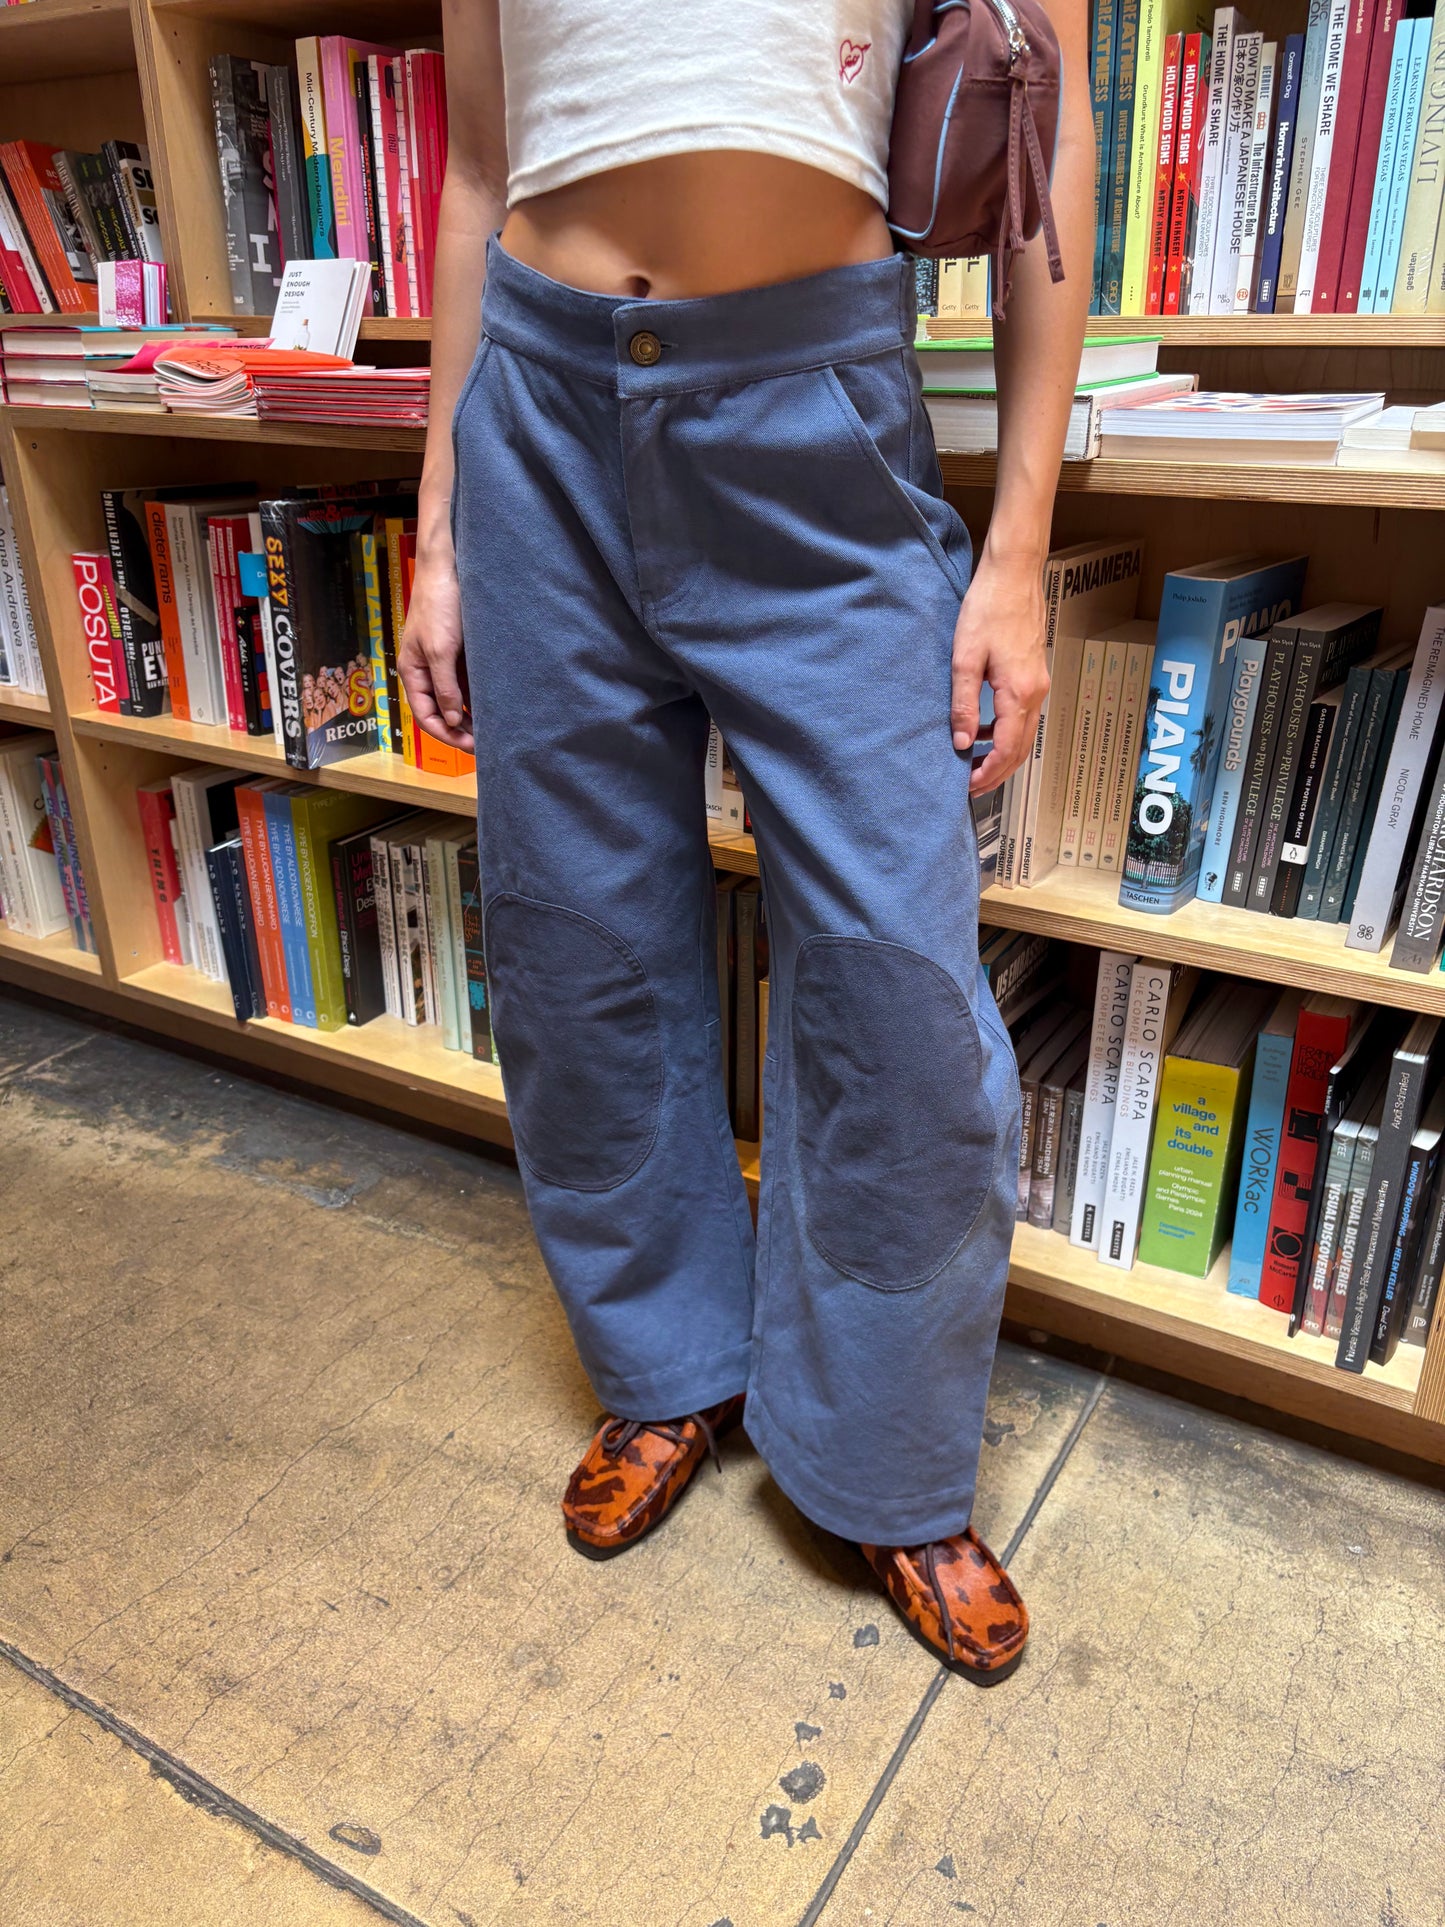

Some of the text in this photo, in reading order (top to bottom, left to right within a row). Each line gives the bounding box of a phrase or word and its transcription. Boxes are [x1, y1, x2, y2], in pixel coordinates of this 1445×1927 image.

[1208, 24, 1228, 147] THE HOME WE SHARE
[1229, 38, 1248, 133] 日本の家の作り方
[1320, 5, 1346, 136] THE HOME WE SHARE
[1160, 66, 1177, 165] HOLLYWOOD SIGNS
[1179, 64, 1196, 164] HOLLYWOOD SIGNS
[1380, 58, 1404, 182] LEARNING FROM LAS VEGAS
[1397, 57, 1422, 182] LEARNING FROM LAS VEGAS
[305, 72, 325, 238] Mid-Century Modern Designers
[1230, 36, 1260, 255] HOW TO MAKE A JAPANESE HOUSE
[1294, 137, 1307, 209] STEPHEN GEE
[330, 136, 351, 226] Mendini
[1243, 142, 1265, 238] The Infrastructure Book
[1267, 121, 1290, 235] Horror in Architecture
[1154, 190, 1166, 257] KATHY KIKKERT
[1172, 189, 1185, 257] KATHY KIKKERT
[1406, 252, 1418, 291] gestalten
[103, 493, 122, 557] EVERYTHING
[152, 511, 172, 605] dieter rams
[265, 536, 289, 607] SEXY
[1062, 549, 1141, 600] PANAMERA
[3, 571, 23, 648] Andreeva
[73, 559, 118, 705] POSUTA
[120, 606, 131, 631] DEAD
[274, 613, 302, 739] COVERS
[1409, 627, 1445, 740] THE REIMAGINED HOME
[325, 717, 377, 743] RECOR
[1034, 714, 1046, 760] PANAMERA
[1080, 716, 1090, 752] PARADISE
[1225, 658, 1259, 772] Playgrounds
[1245, 651, 1285, 816] PLAYHOUSES AND PRIVILEGE
[1270, 655, 1313, 821] PLAYHOUSES AND PRIVILEGE
[1075, 765, 1084, 789] SMALL
[1079, 754, 1086, 764] OF
[1139, 659, 1196, 836] PIANO
[1072, 791, 1081, 818] HOUSES
[1214, 804, 1226, 846] HIGHMORE
[1387, 768, 1410, 830] NICOLE GRAY
[269, 822, 279, 843] TYPE
[283, 823, 291, 844] TYPE
[298, 827, 307, 847] TYPE
[996, 834, 1007, 878] POURSUITE
[1004, 838, 1015, 882] POURSUITE
[1022, 837, 1033, 881] POURSUITE
[231, 860, 246, 930] TO EVELYN
[275, 856, 284, 878] ALDO
[288, 857, 297, 880] ALDO
[303, 859, 313, 889] ROGER
[1406, 793, 1445, 937] HOUGHTON LIBRARY HARVARD UNIVERSITY
[209, 864, 226, 934] TO EVELYN
[279, 879, 291, 925] NOVARESE
[291, 880, 303, 928] NOVARESE
[306, 889, 318, 938] EXCOFFON
[1126, 891, 1160, 905] TASCHEN
[1089, 963, 1113, 1102] THE COMPLETE BUILDINGS
[1101, 964, 1131, 1105] CARLO SCARPA
[1119, 975, 1146, 1118] THE COMPLETE BUILDINGS
[1131, 978, 1164, 1121] CARLO SCARPA
[1172, 1103, 1217, 1121] village
[1193, 1121, 1219, 1136] and
[1197, 1096, 1206, 1106] a
[1167, 1138, 1214, 1158] double
[1175, 1126, 1192, 1139] its
[1337, 1137, 1350, 1158] YEE
[1360, 1140, 1374, 1161] YEE
[1155, 1193, 1180, 1205] Games
[1156, 1186, 1207, 1205] and Paralympic
[1158, 1169, 1213, 1188] planning manual
[1171, 1182, 1200, 1195] Olympic
[1174, 1165, 1194, 1175] urban
[1243, 1127, 1276, 1215] WORKac
[1273, 1260, 1296, 1272] Robert
[1312, 1182, 1342, 1292] VISUAL DISCOVERIES
[1335, 1187, 1365, 1296] VISUAL DISCOVERIES
